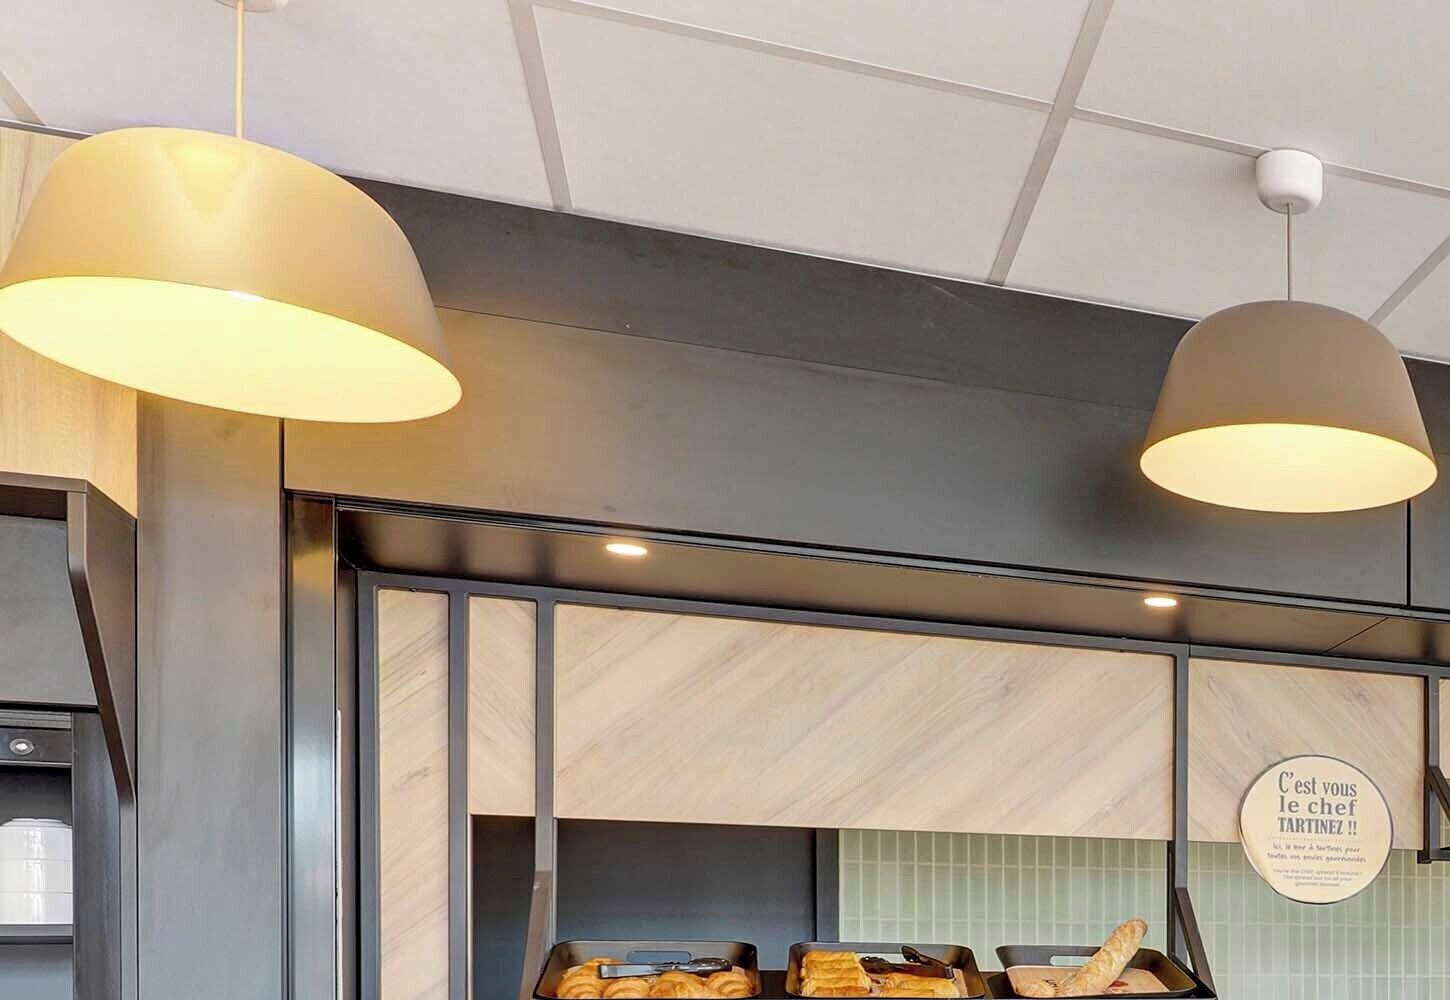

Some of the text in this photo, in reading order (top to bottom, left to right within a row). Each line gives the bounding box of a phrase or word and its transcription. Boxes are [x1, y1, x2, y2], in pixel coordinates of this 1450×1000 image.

[1278, 771, 1358, 797] C'est vous
[1279, 795, 1358, 816] le chef
[1277, 817, 1357, 836] TARTINEZ !!
